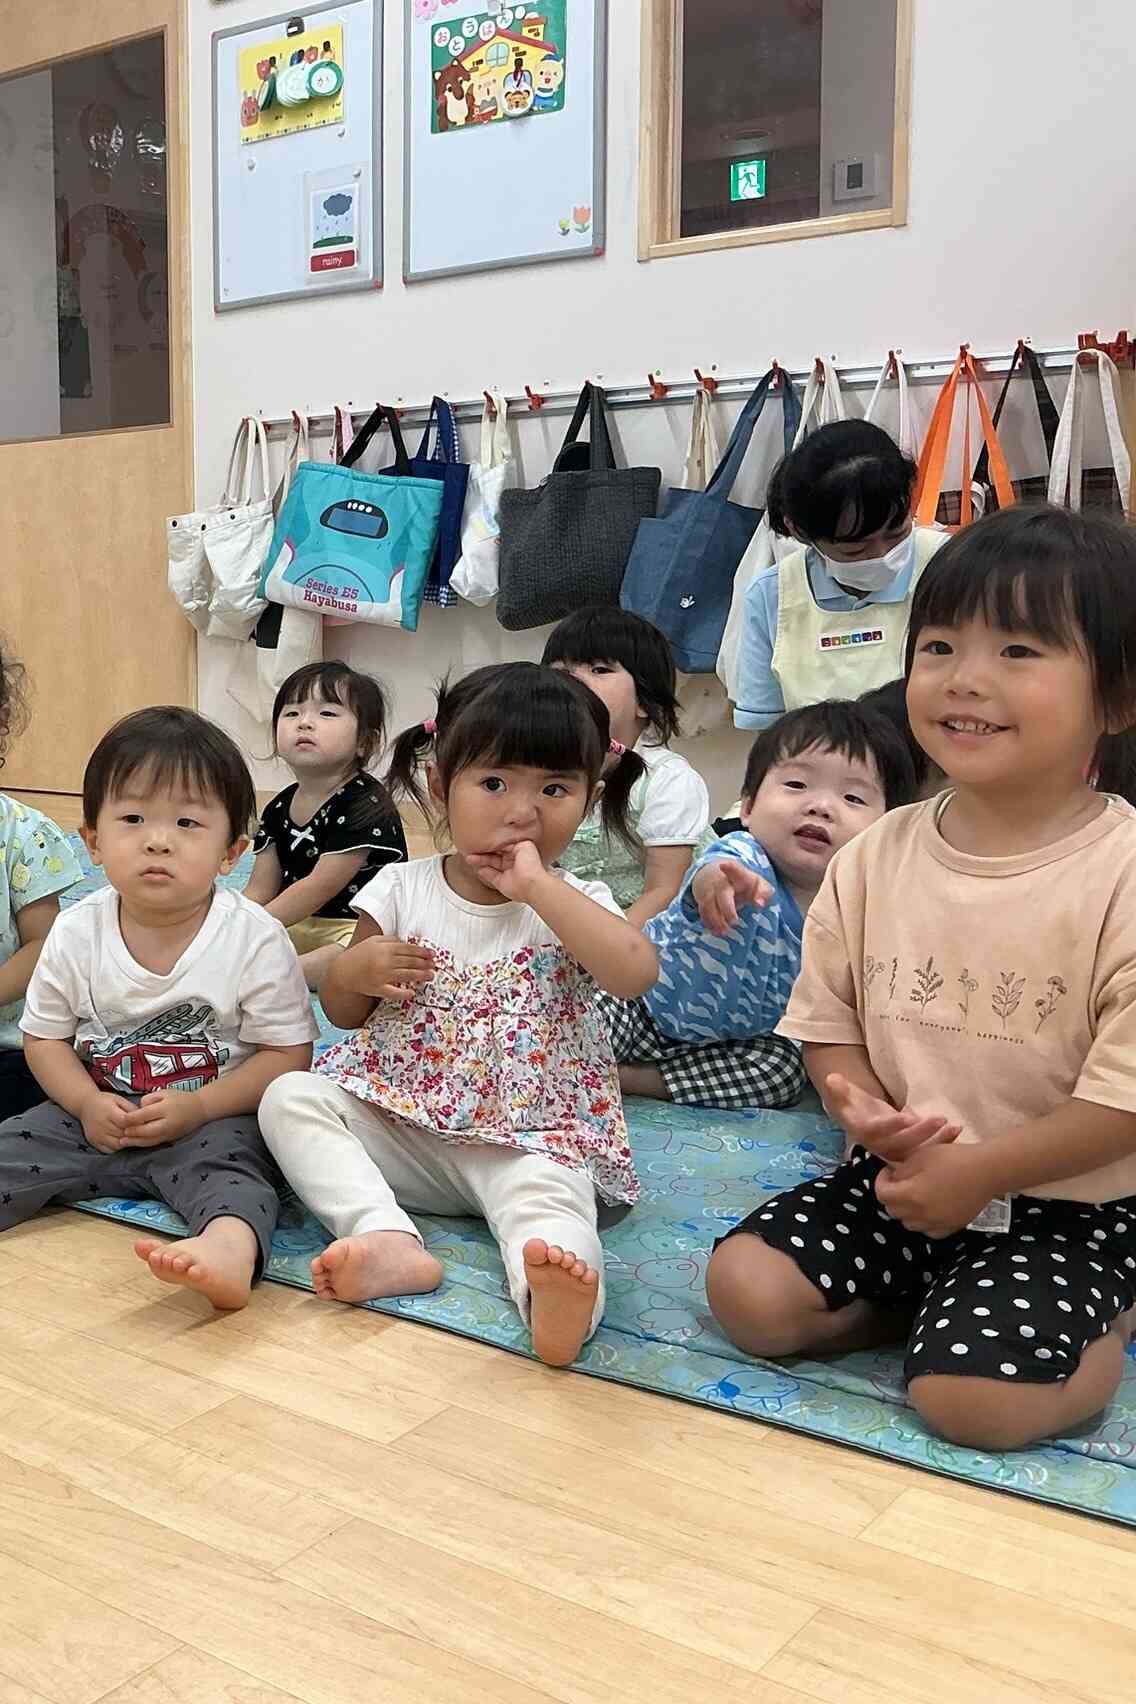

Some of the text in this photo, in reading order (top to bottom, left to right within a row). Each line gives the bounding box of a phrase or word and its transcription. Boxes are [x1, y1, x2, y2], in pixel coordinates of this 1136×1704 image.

[322, 256, 343, 267] rainy
[306, 578, 359, 599] Series E5
[304, 589, 358, 612] Hayabusa
